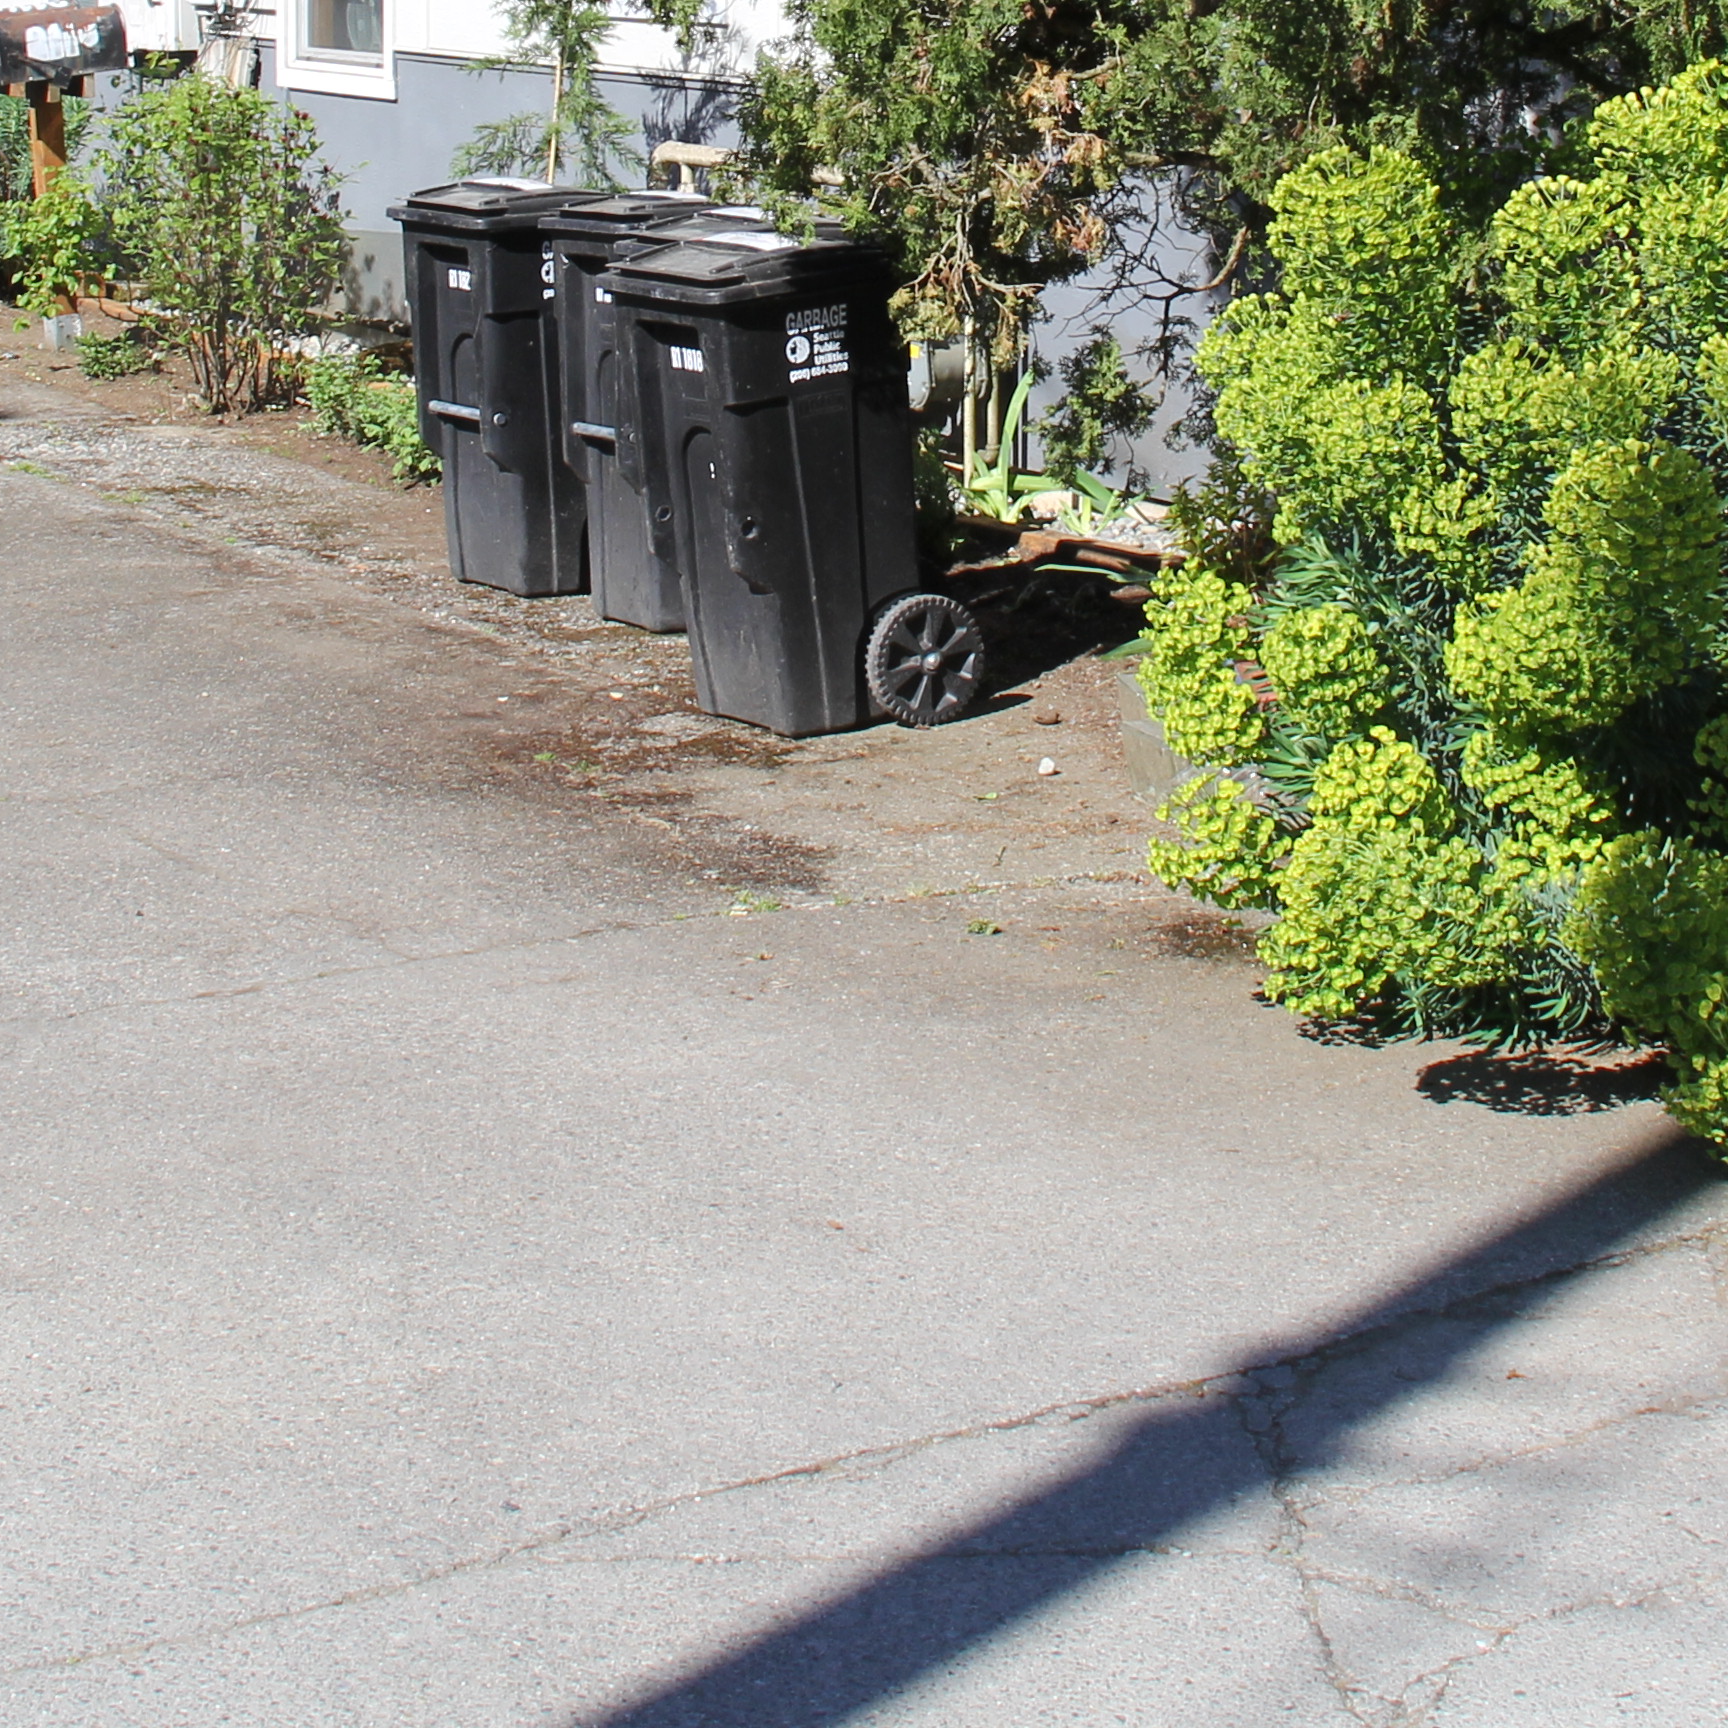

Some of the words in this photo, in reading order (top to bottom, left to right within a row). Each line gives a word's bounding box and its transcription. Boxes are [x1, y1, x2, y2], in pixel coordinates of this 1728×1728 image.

[786, 304, 848, 334] GARBAGE
[813, 329, 845, 343] Seattle
[813, 340, 841, 354] Public
[813, 351, 850, 366] Utilities
